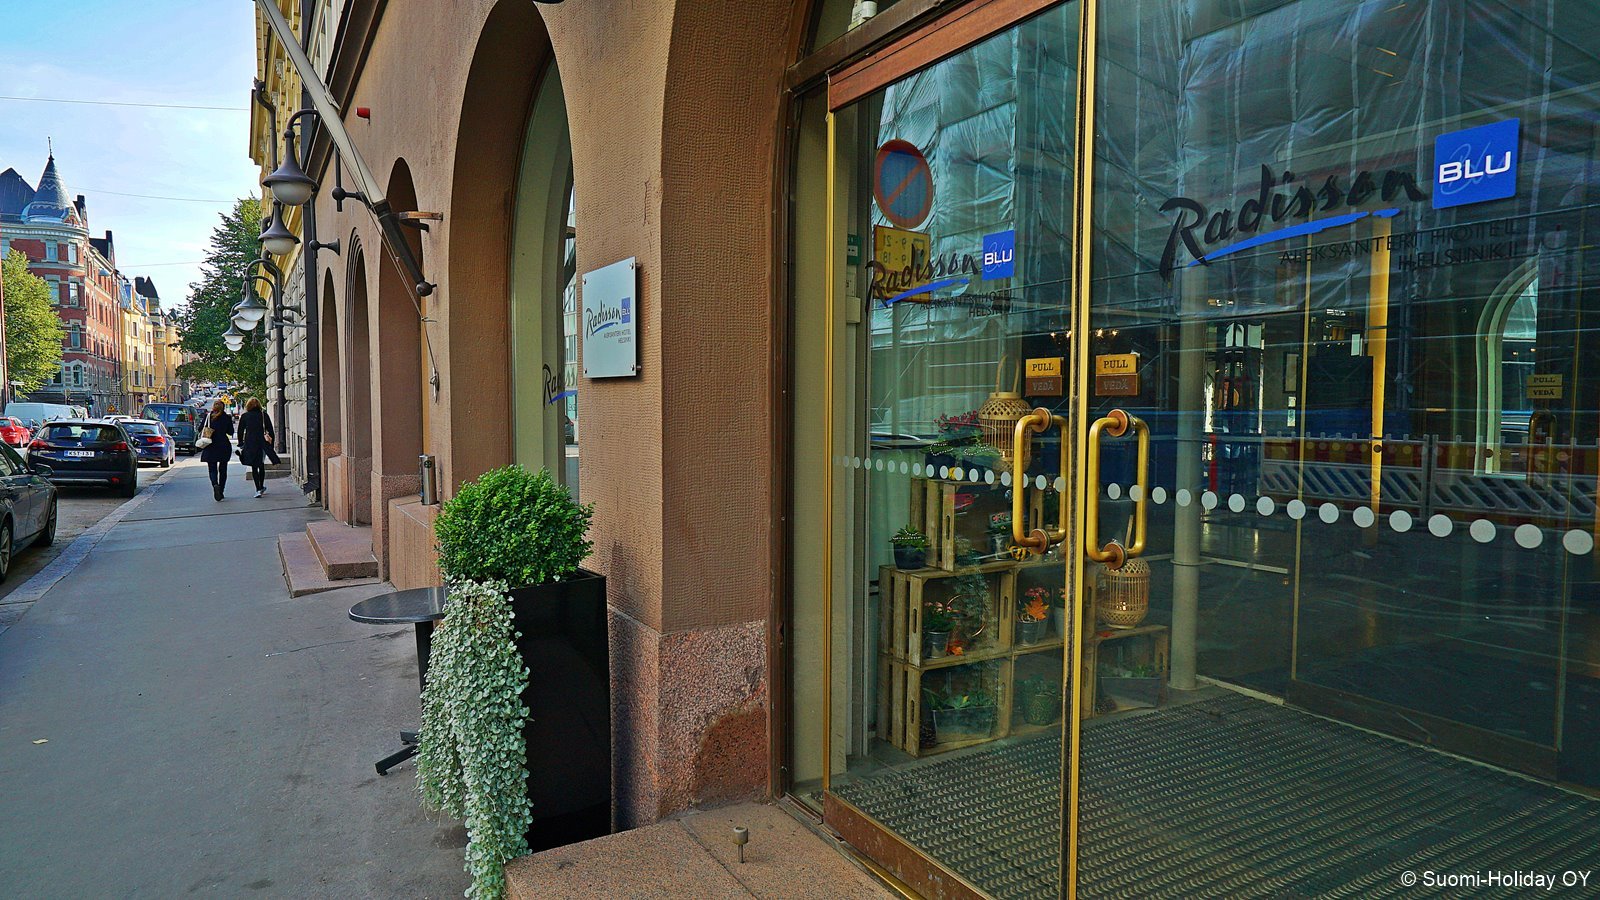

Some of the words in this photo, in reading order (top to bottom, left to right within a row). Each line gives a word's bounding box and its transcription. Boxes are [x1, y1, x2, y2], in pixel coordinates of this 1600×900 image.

[1158, 164, 1429, 280] Radisson
[1438, 150, 1511, 184] BLU
[865, 244, 979, 314] Radisson
[984, 249, 1013, 265] BLU
[585, 299, 621, 341] Radisson
[1032, 362, 1054, 371] PULL
[1103, 360, 1129, 369] PULL
[1032, 380, 1054, 391] VEDÄ
[1103, 379, 1129, 390] VEDÄ
